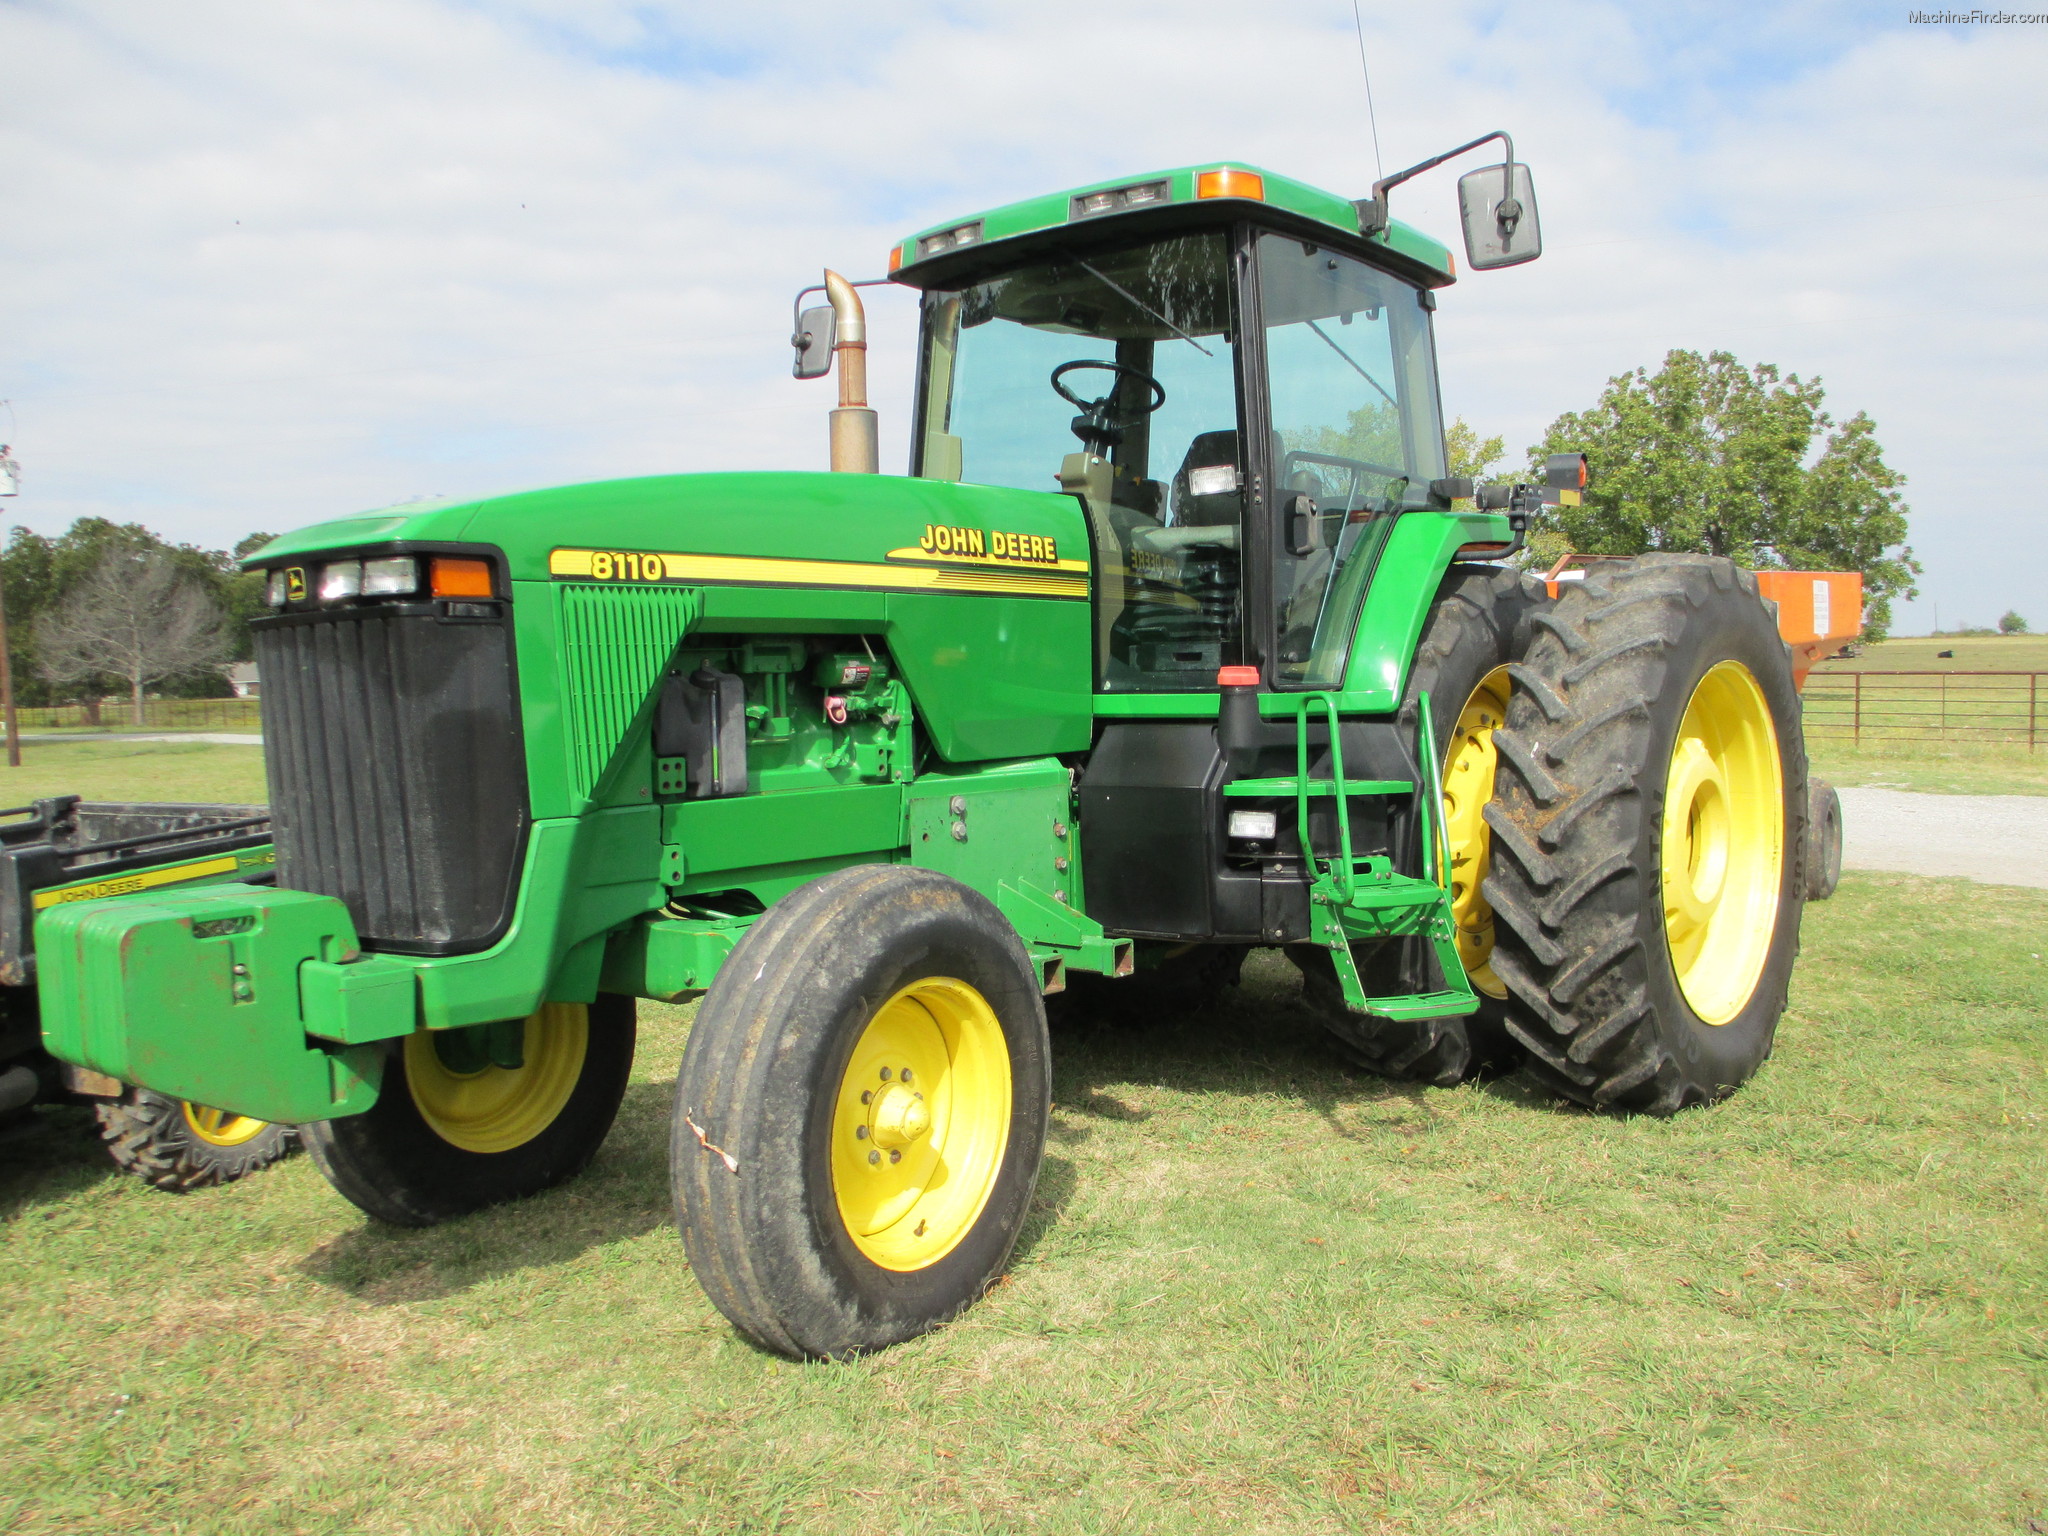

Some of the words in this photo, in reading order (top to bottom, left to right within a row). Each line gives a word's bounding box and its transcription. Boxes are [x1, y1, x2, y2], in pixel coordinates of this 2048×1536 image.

[920, 523, 986, 557] JOHN
[992, 531, 1058, 564] DEERE
[591, 551, 666, 581] 8110
[58, 887, 98, 903] JOHN
[97, 878, 144, 898] DEERE
